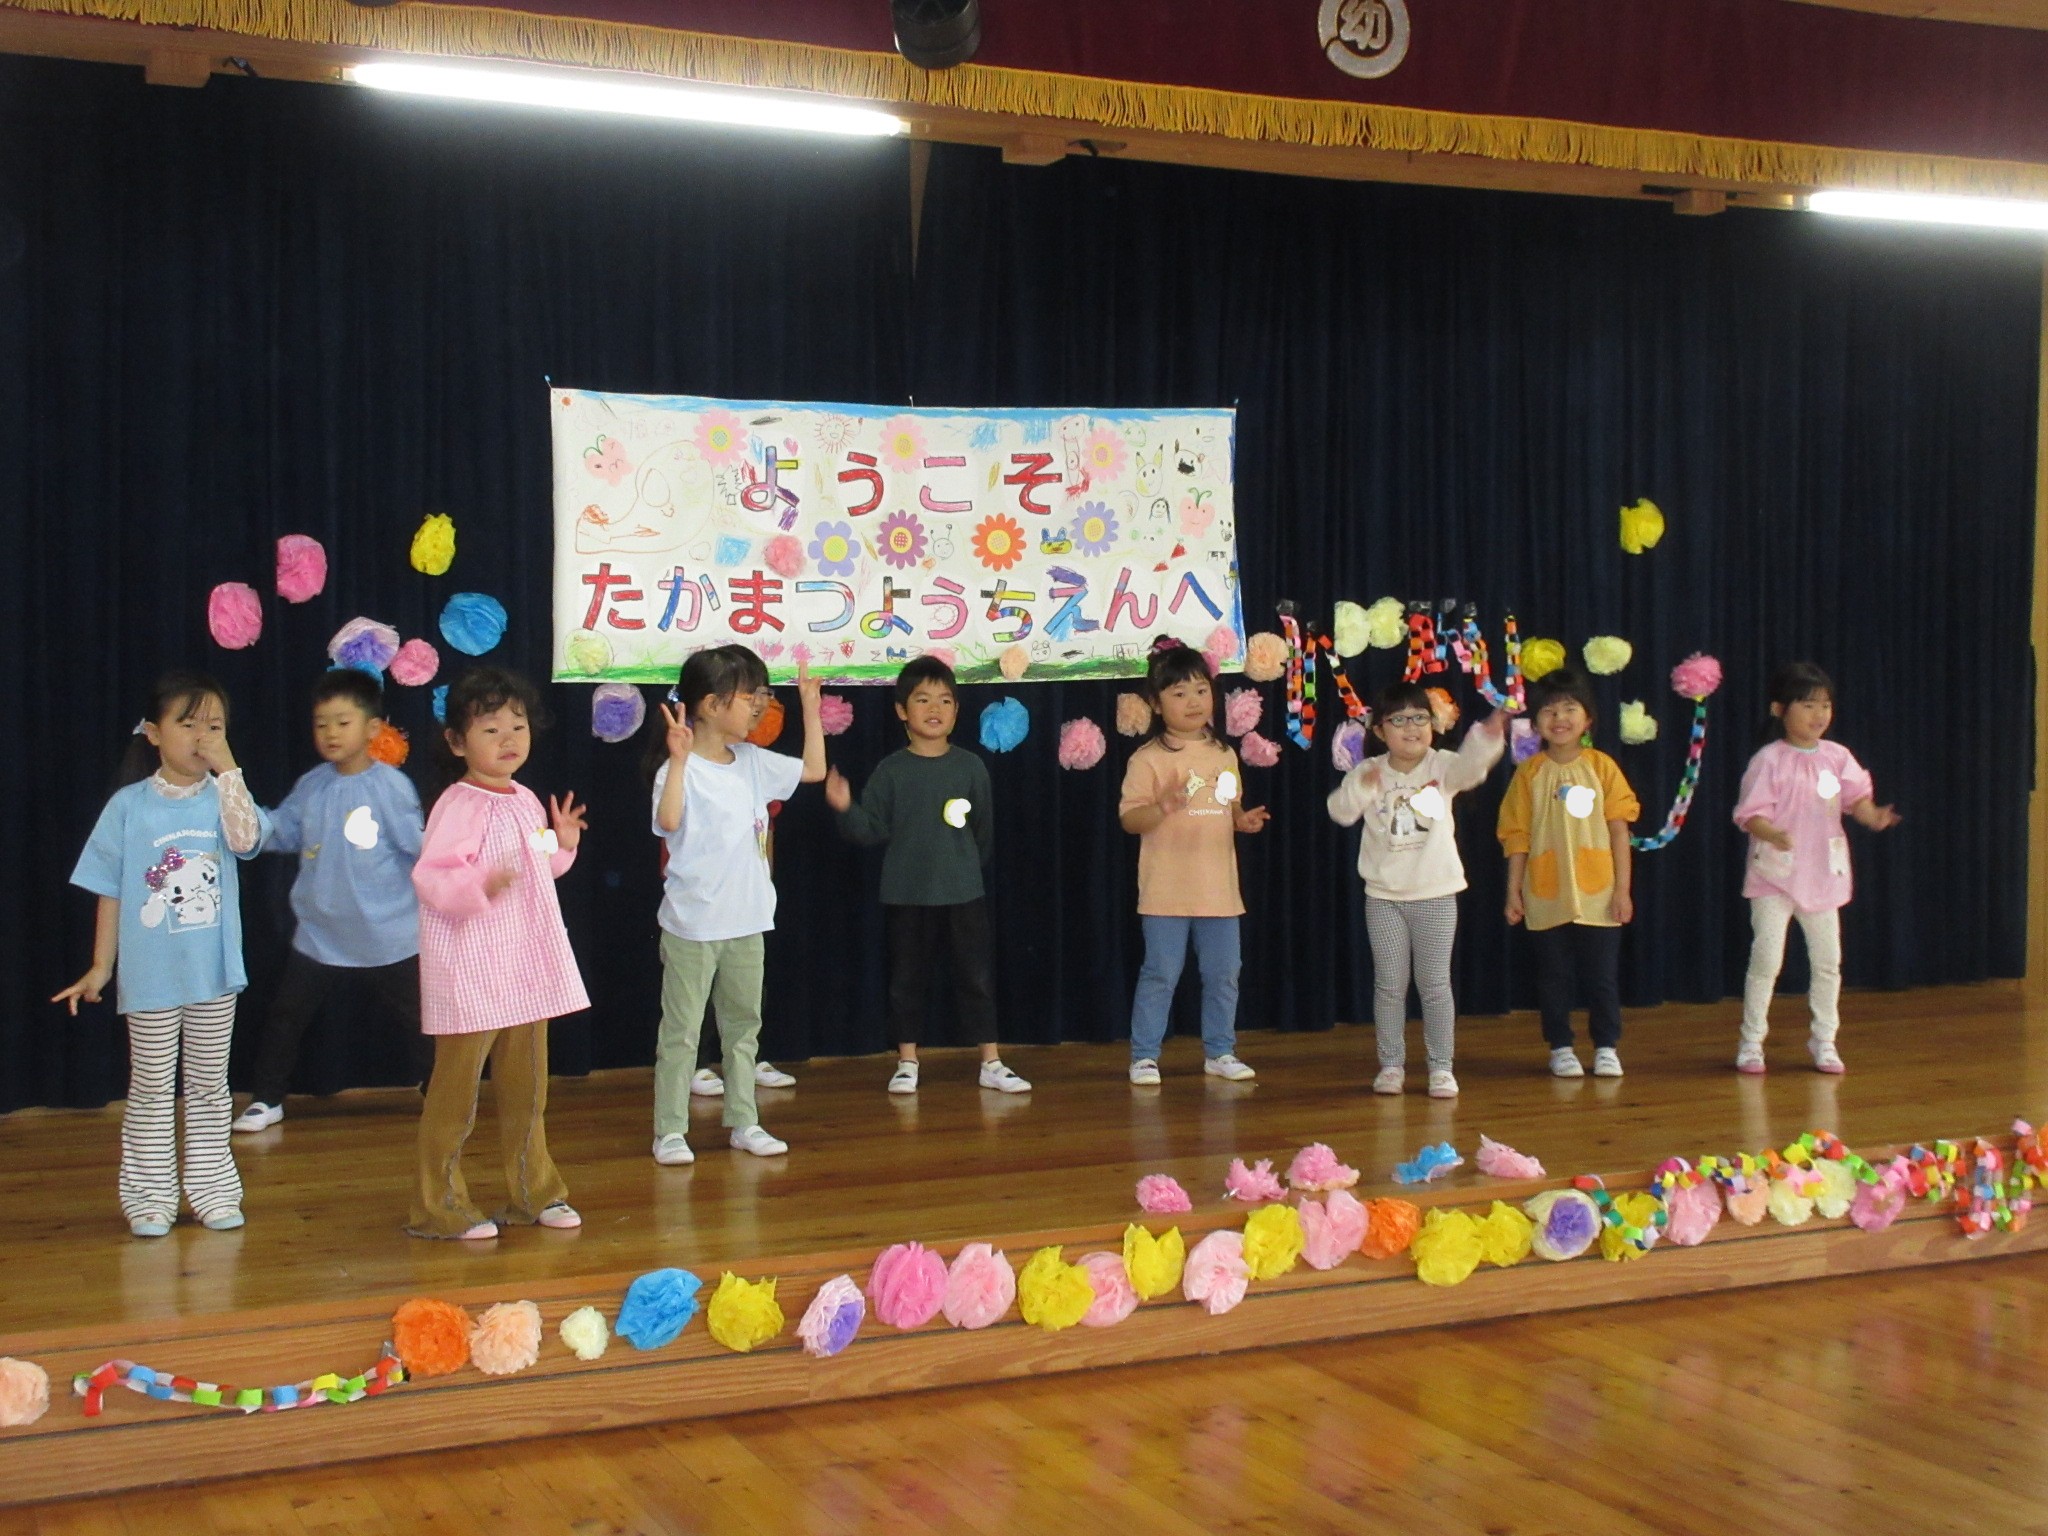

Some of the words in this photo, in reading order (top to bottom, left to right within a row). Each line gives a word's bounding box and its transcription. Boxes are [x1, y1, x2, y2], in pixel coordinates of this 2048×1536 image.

[740, 446, 1063, 516] ようこそ
[581, 562, 1224, 643] たかまつようちえんへ
